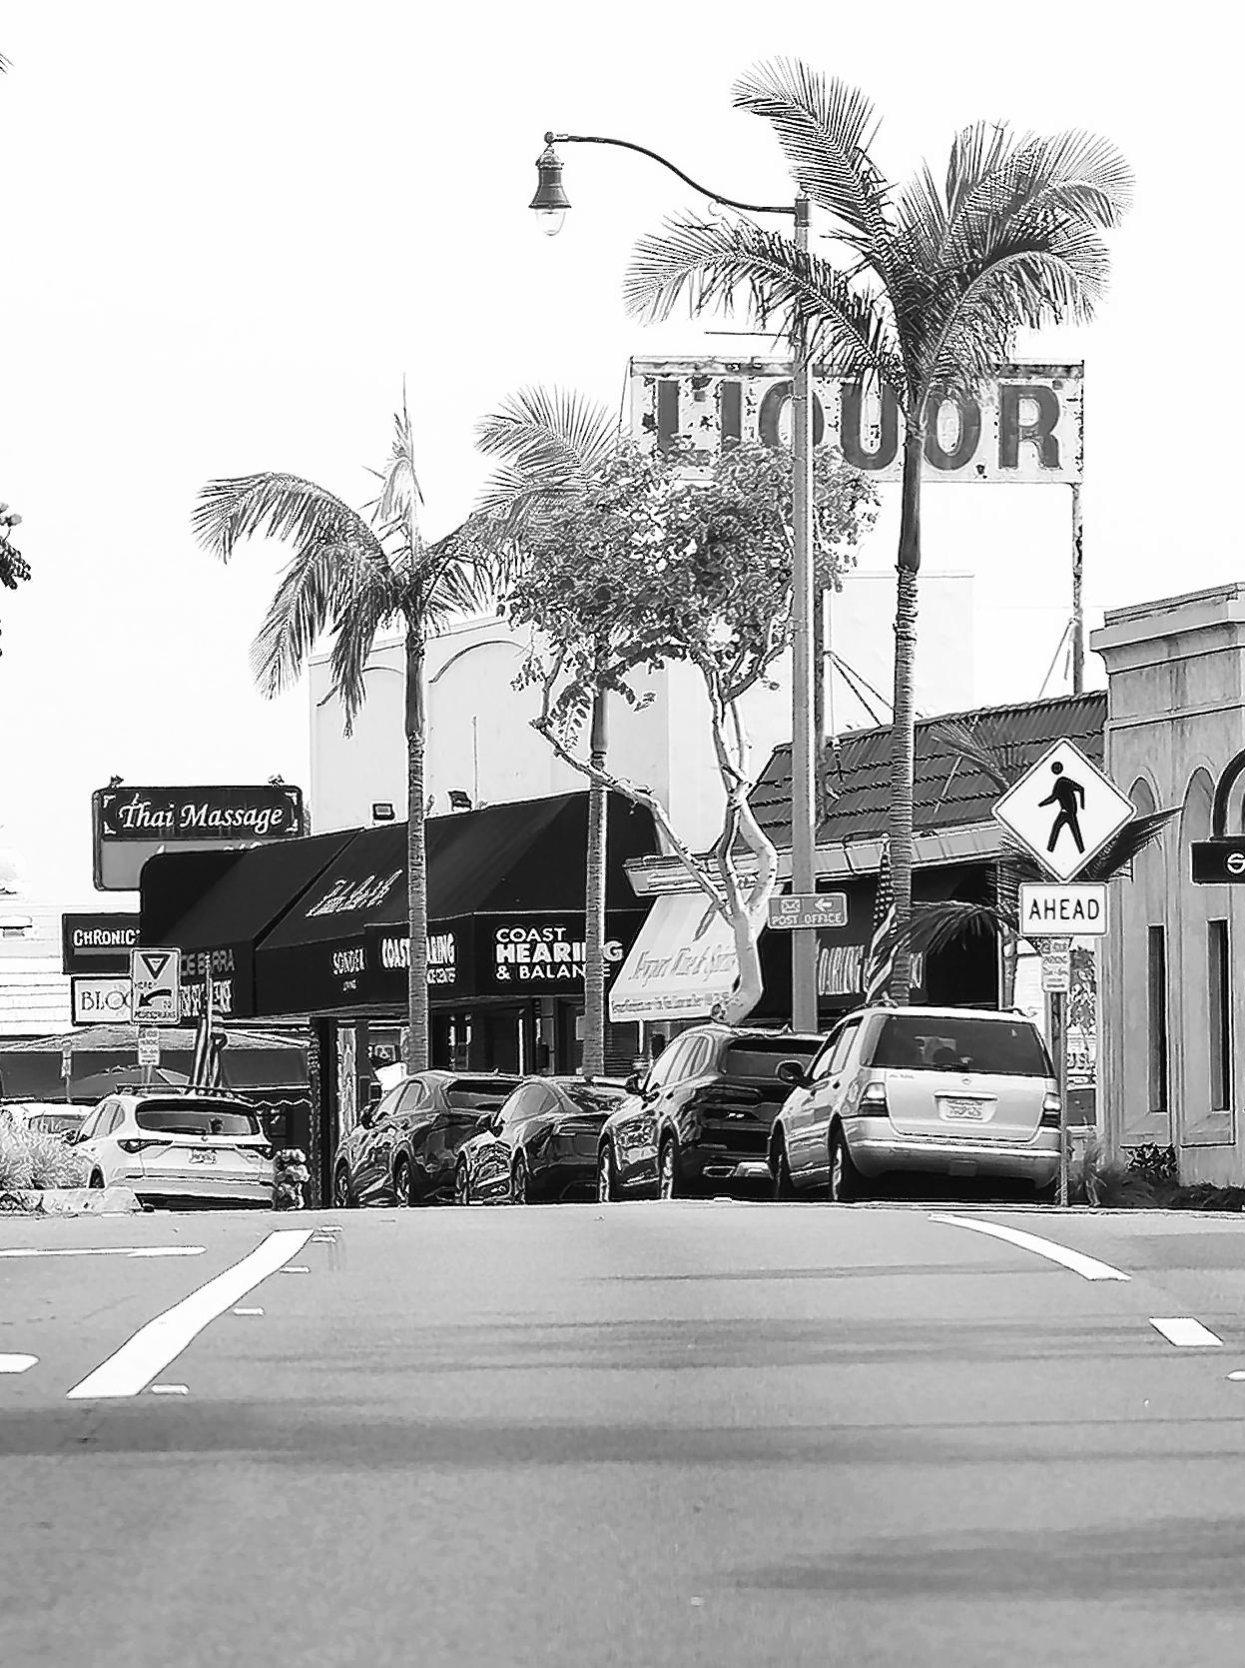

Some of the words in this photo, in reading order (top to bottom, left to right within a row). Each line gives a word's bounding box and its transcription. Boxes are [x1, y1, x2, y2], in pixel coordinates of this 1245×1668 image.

[118, 792, 175, 829] Thai
[179, 803, 283, 835] Massage
[771, 916, 799, 925] POST
[803, 912, 842, 924] OFFICE
[1028, 900, 1100, 922] AHEAD
[495, 927, 567, 943] COAST
[496, 940, 624, 963] HEARIG
[496, 965, 511, 979] &
[519, 963, 611, 980] BALANE
